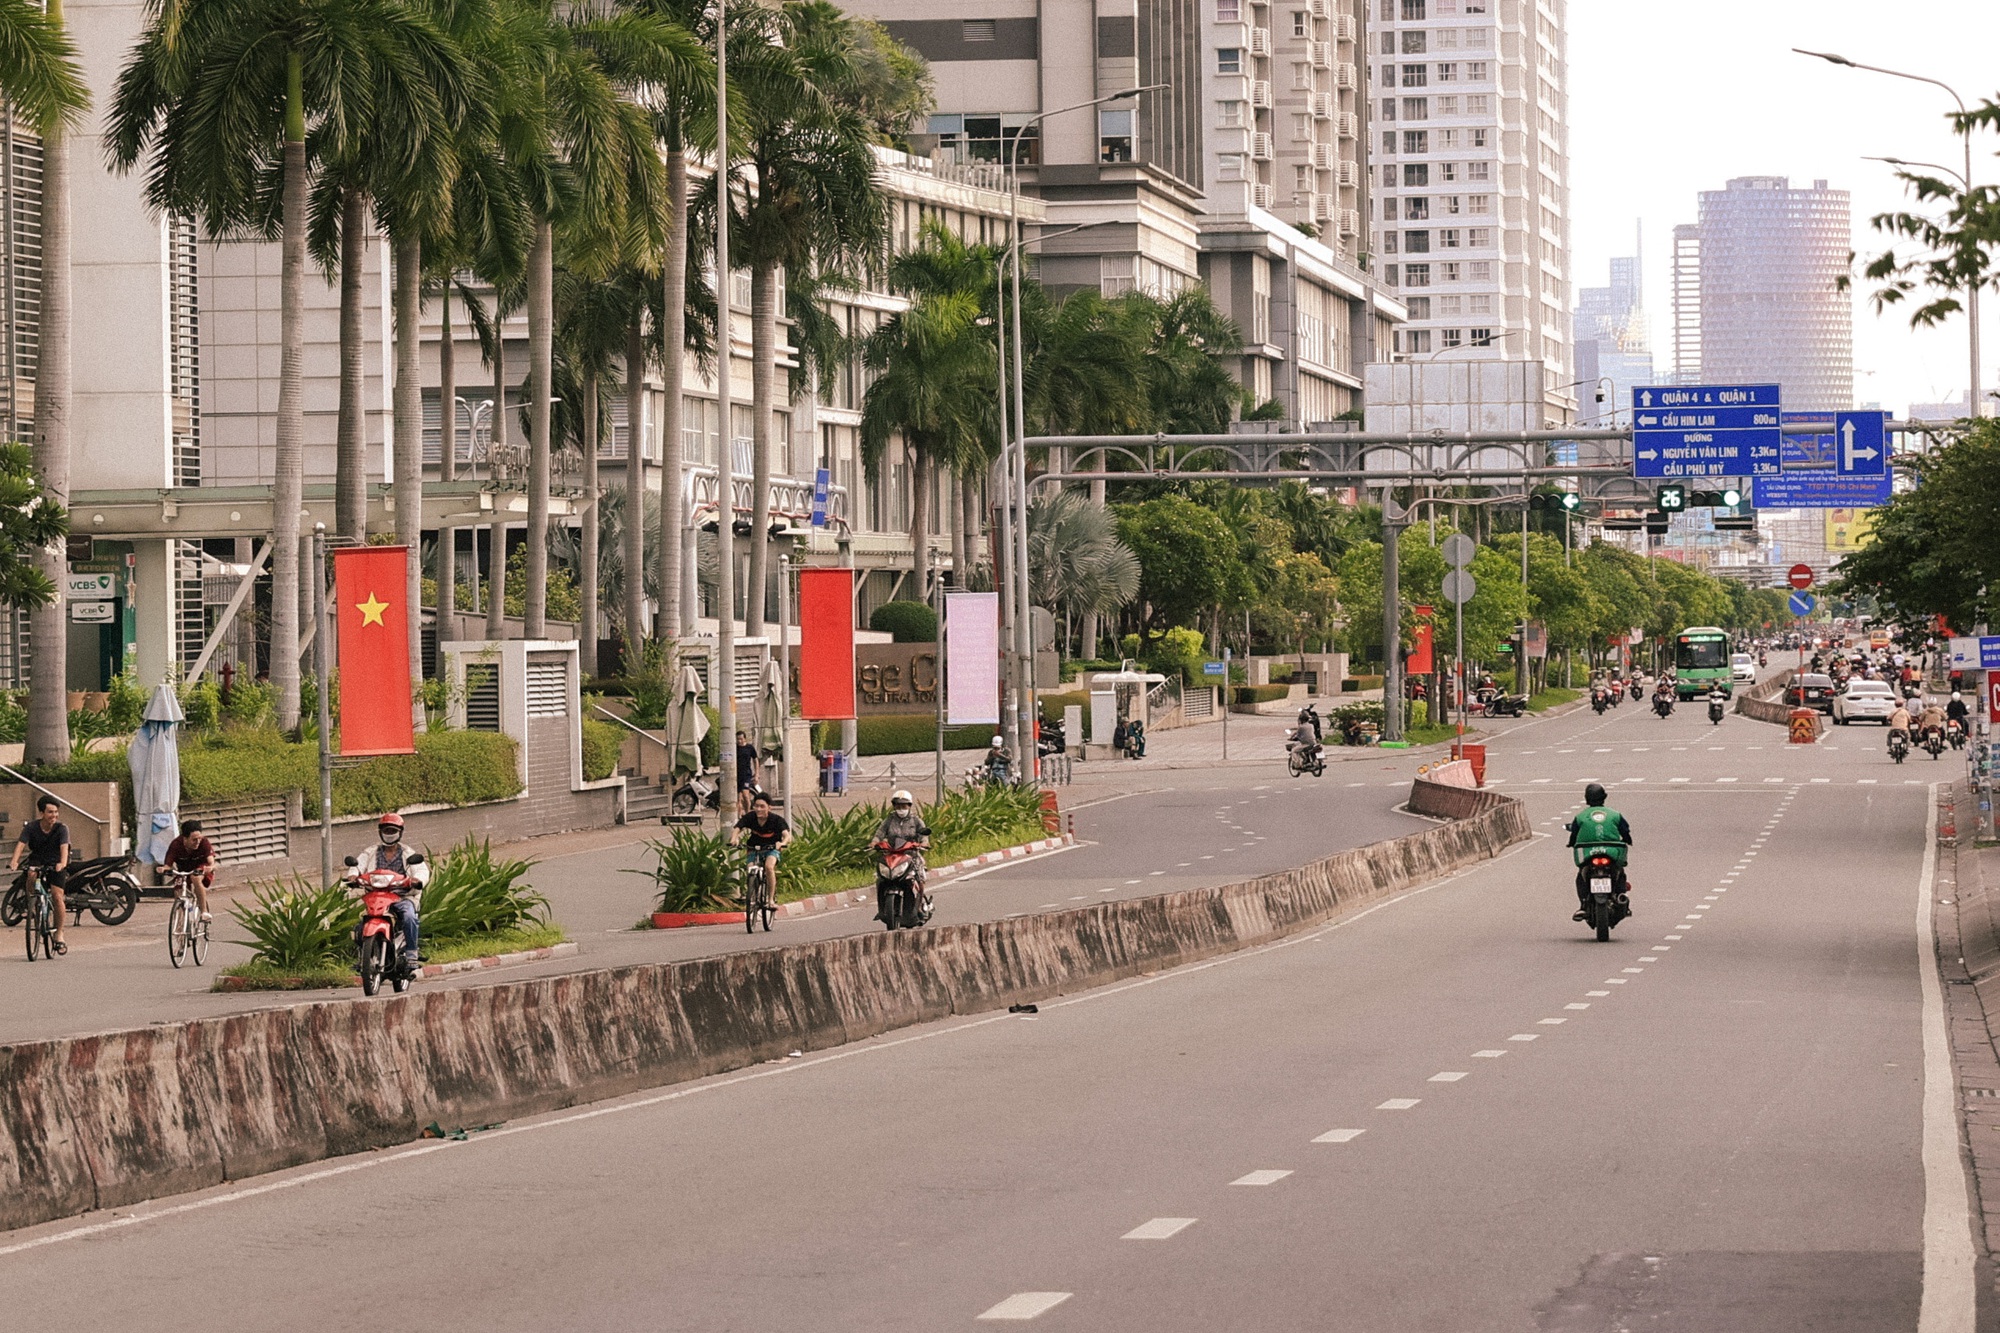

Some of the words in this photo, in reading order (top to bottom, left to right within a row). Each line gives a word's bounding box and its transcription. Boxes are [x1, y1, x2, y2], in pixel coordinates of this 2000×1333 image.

[1662, 390, 1689, 406] QUẬN
[1691, 392, 1698, 403] 4
[1704, 393, 1712, 402] &
[1719, 389, 1746, 404] QUẬN
[1749, 391, 1755, 402] 1
[1680, 415, 1696, 426] HIM
[1698, 415, 1715, 426] LAM
[1753, 414, 1777, 425] 800m
[1684, 432, 1713, 443] ĐƯỜNG
[1699, 445, 1717, 458] VĂN
[1718, 446, 1738, 458] LINH
[1750, 446, 1777, 459] 2,3Km
[1686, 461, 1706, 475] PHÚ
[1709, 461, 1725, 475] MỸ
[1752, 463, 1778, 475] 3,3Km
[1661, 490, 1681, 507] 26
[69, 581, 97, 590] VCBS
